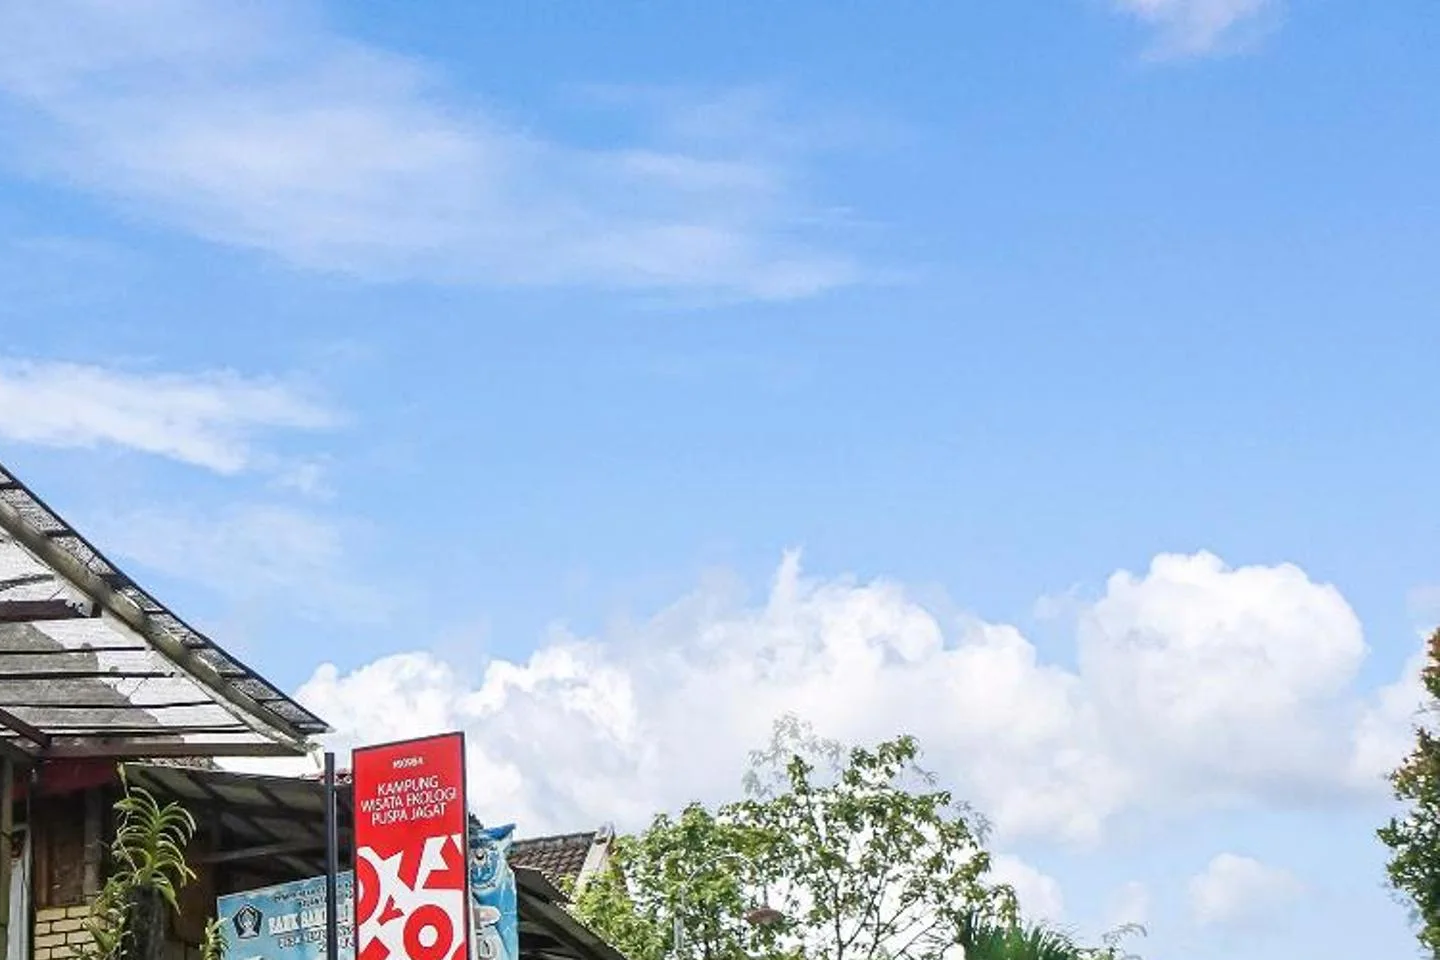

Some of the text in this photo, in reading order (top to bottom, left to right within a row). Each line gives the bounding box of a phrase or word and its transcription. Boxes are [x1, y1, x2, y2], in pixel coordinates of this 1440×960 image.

[377, 775, 439, 797] KAMPUNG
[361, 787, 456, 813] WISATA EKOLOGI
[371, 802, 447, 826] PUSPA JAGAT
